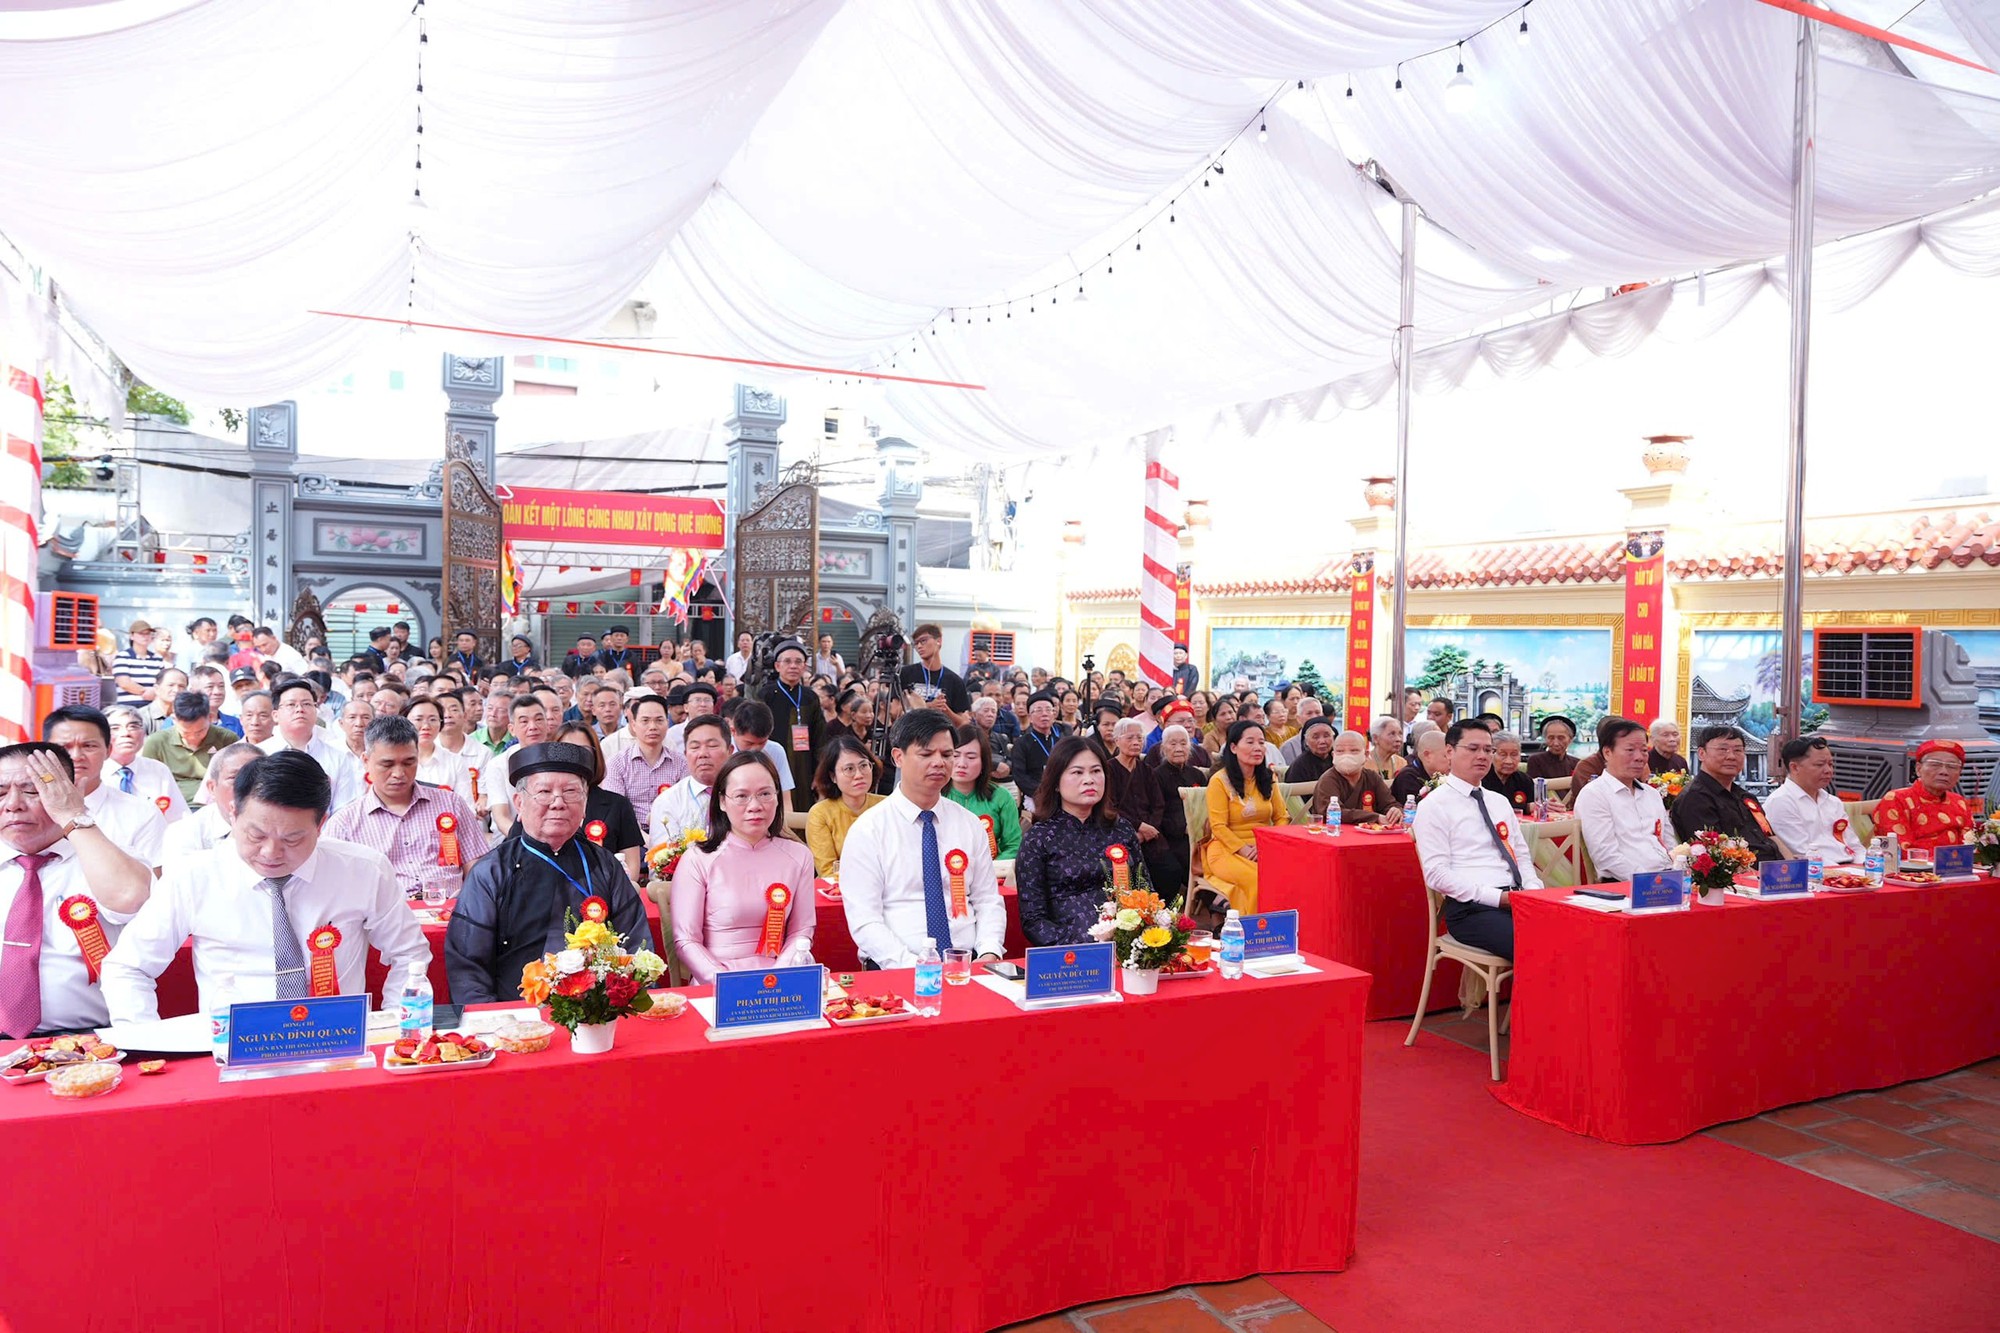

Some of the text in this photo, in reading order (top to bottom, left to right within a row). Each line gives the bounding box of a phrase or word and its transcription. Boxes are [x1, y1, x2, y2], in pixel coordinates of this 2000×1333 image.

[503, 499, 722, 536] OÀN KẾT MỘT LÒNG CÙNG NHAU XÂY DỰNG QUÊ HƯƠNG
[1637, 602, 1648, 618] CHO
[1634, 698, 1645, 714] CHO
[736, 998, 762, 1007] PHẠM
[764, 997, 778, 1005] THỊ
[238, 1027, 356, 1043] NGUYỄN ĐÌNH QUANG
